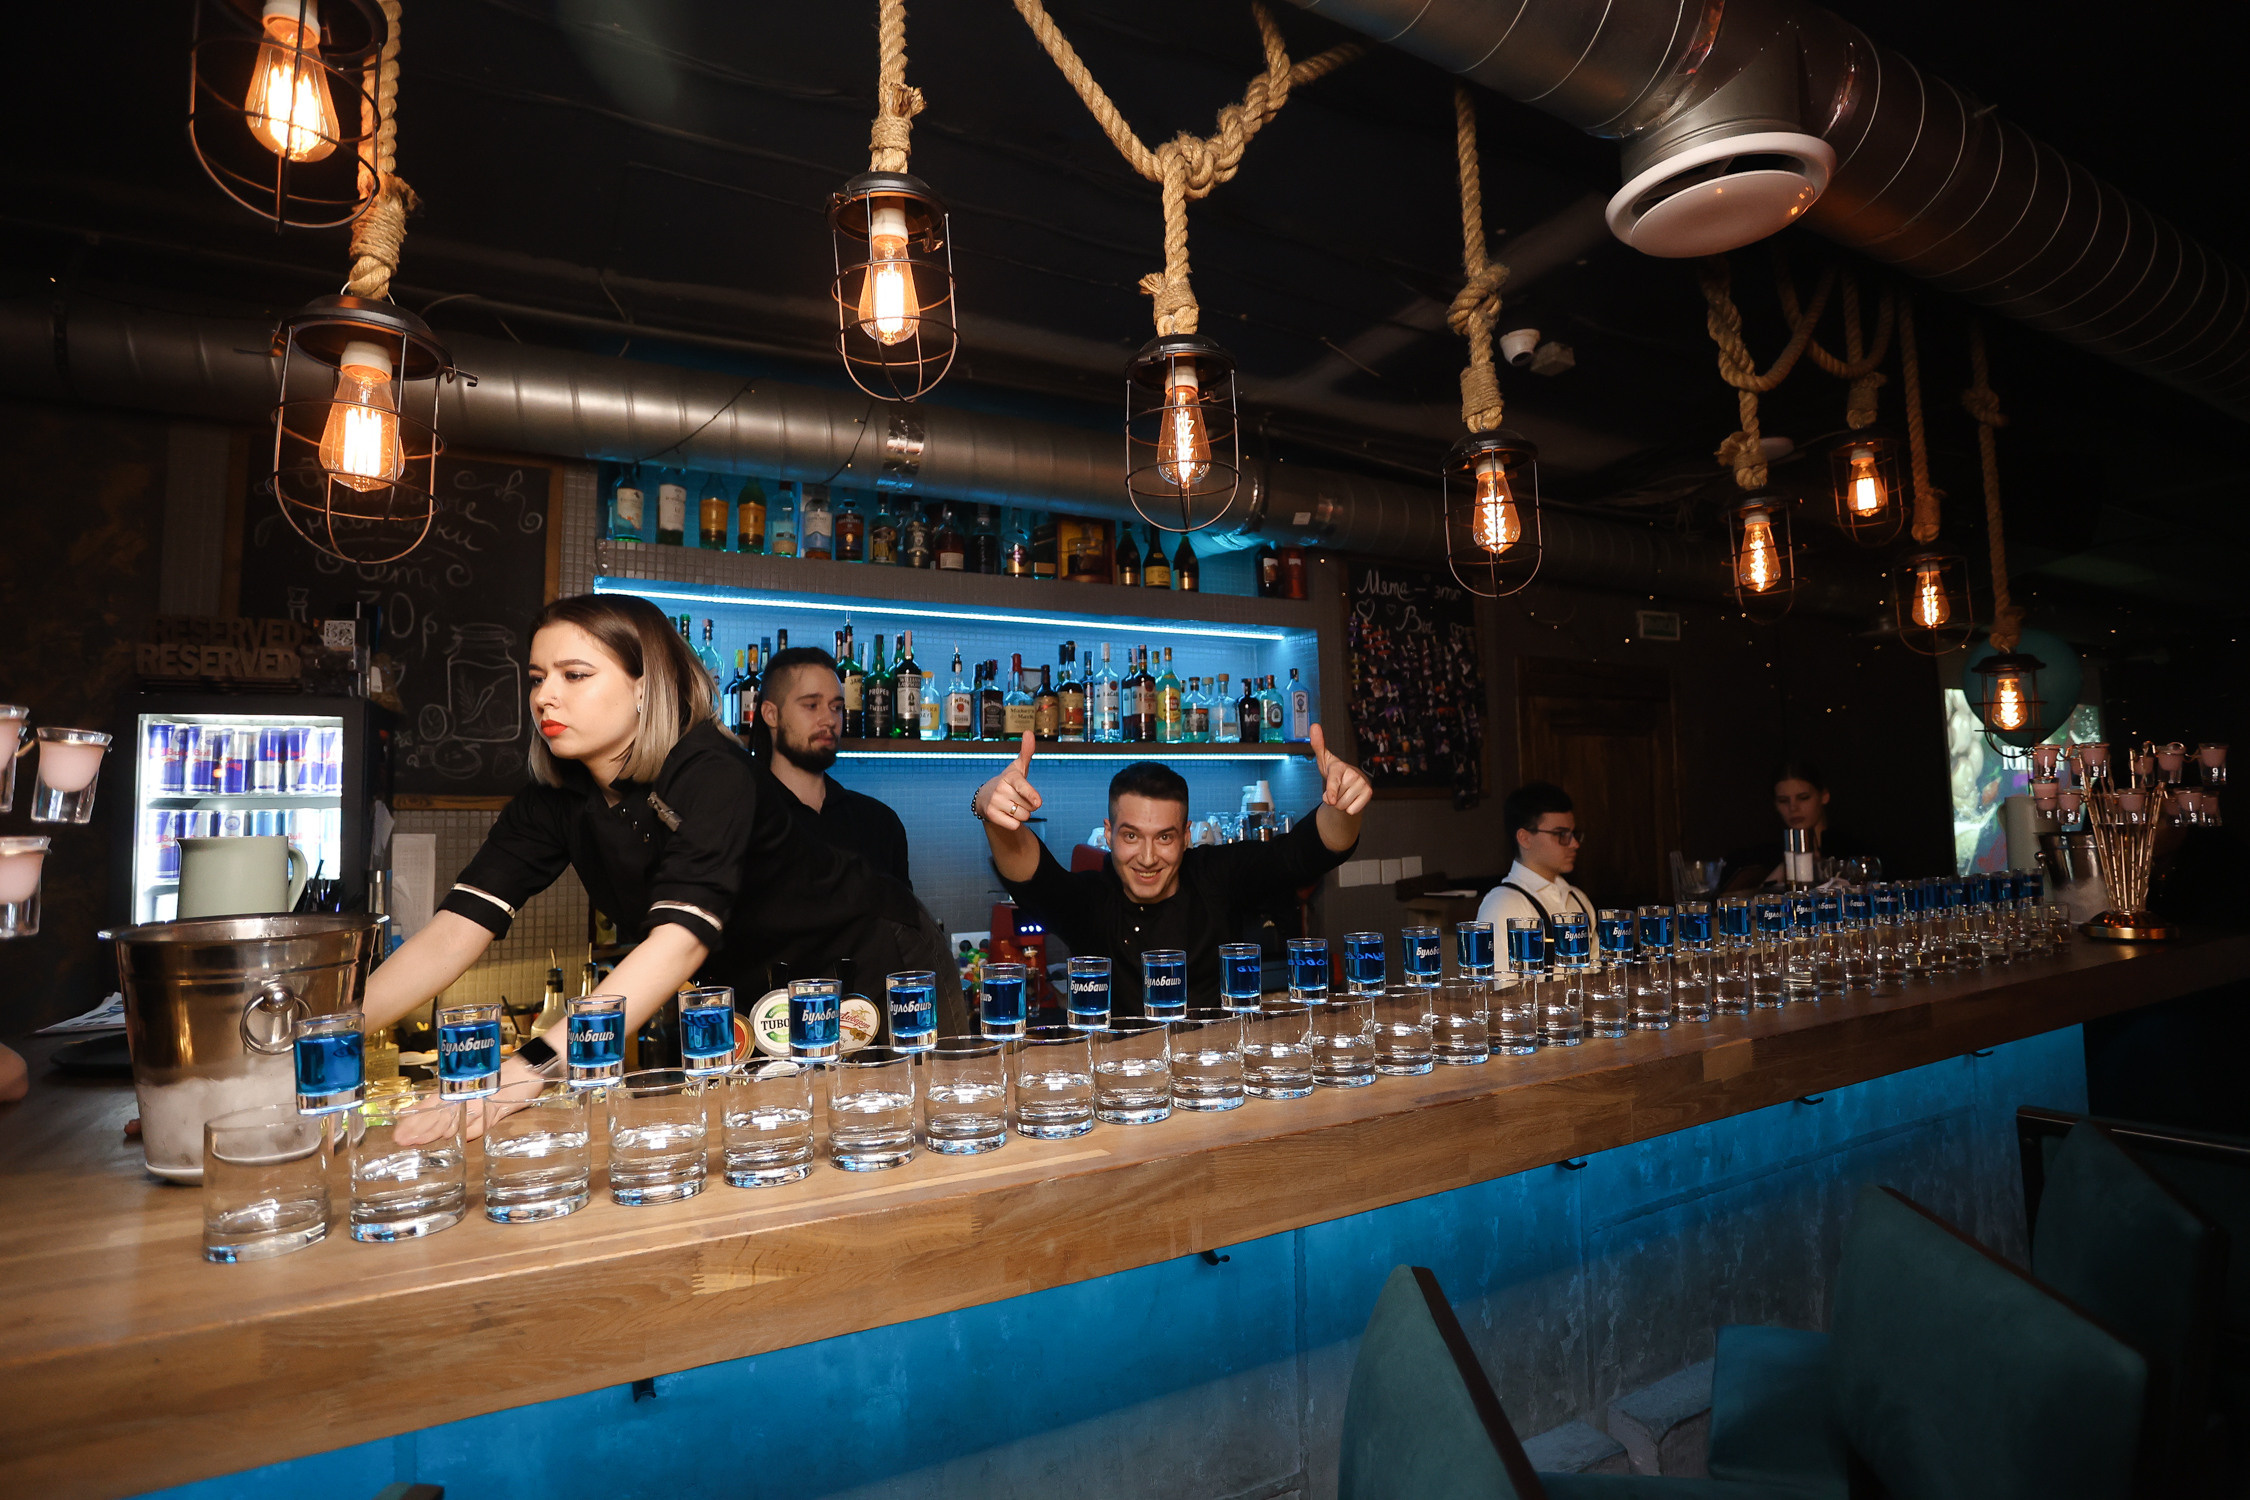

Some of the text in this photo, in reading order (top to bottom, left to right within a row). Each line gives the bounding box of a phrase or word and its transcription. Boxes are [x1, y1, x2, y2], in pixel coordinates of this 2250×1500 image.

[153, 615, 305, 651] RESERVED
[136, 642, 302, 679] RESERVED
[1070, 980, 1109, 995] Бульбашъ
[441, 1035, 496, 1057] Бульбашъ
